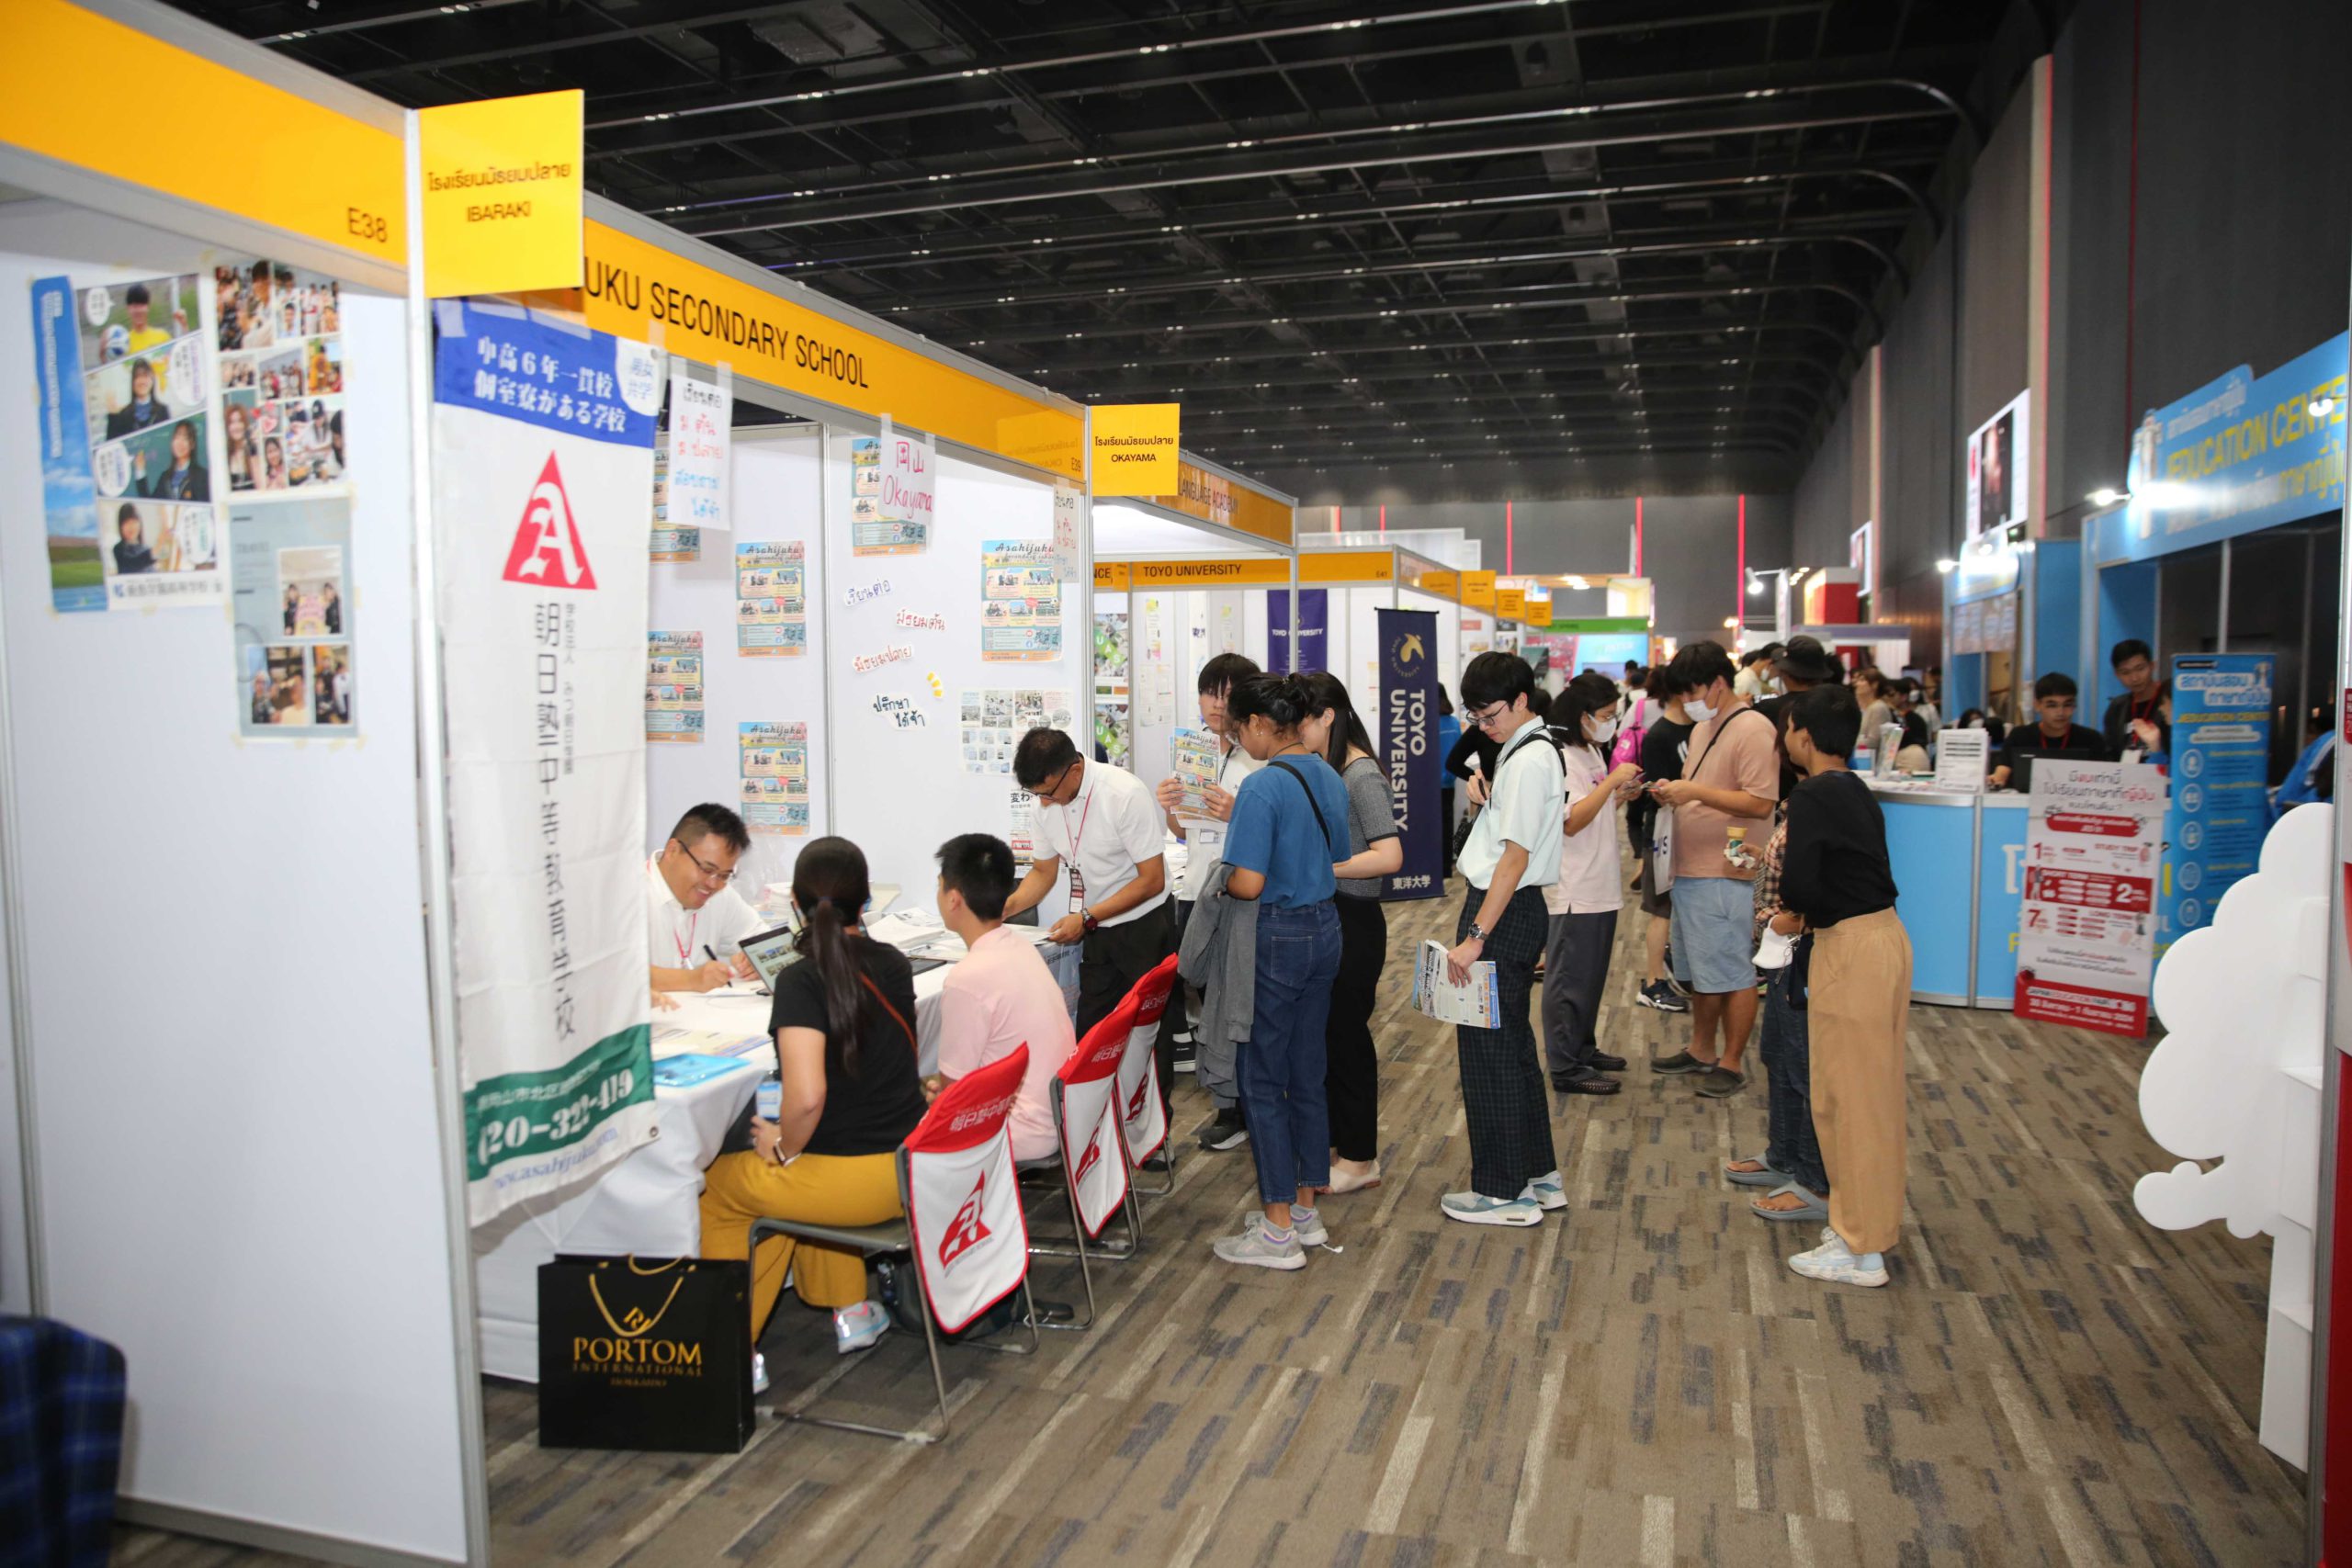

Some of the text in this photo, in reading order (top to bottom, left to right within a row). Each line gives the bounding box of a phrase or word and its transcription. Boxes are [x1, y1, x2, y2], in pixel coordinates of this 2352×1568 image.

[467, 200, 531, 222] IBARAKI
[347, 207, 388, 243] E38
[571, 255, 868, 389] UKU SECONDARY SCHOOL
[1094, 434, 1174, 447] โรงเรียนมัธยมปลาย
[1070, 457, 1081, 472] E39
[1111, 454, 1157, 463] OKAYAMA
[883, 474, 933, 520] Okayama
[1143, 564, 1242, 578] TOYO UNIVERSITY
[1409, 689, 1427, 756] TOYO
[1389, 689, 1408, 831] UNIVERSITY
[1010, 793, 1033, 803] 変わ
[2033, 842, 2042, 860] 1
[1392, 874, 1431, 890] 東洋大学
[2116, 883, 2133, 903] 2
[2028, 908, 2041, 928] 7
[573, 1337, 702, 1366] PORTOM
